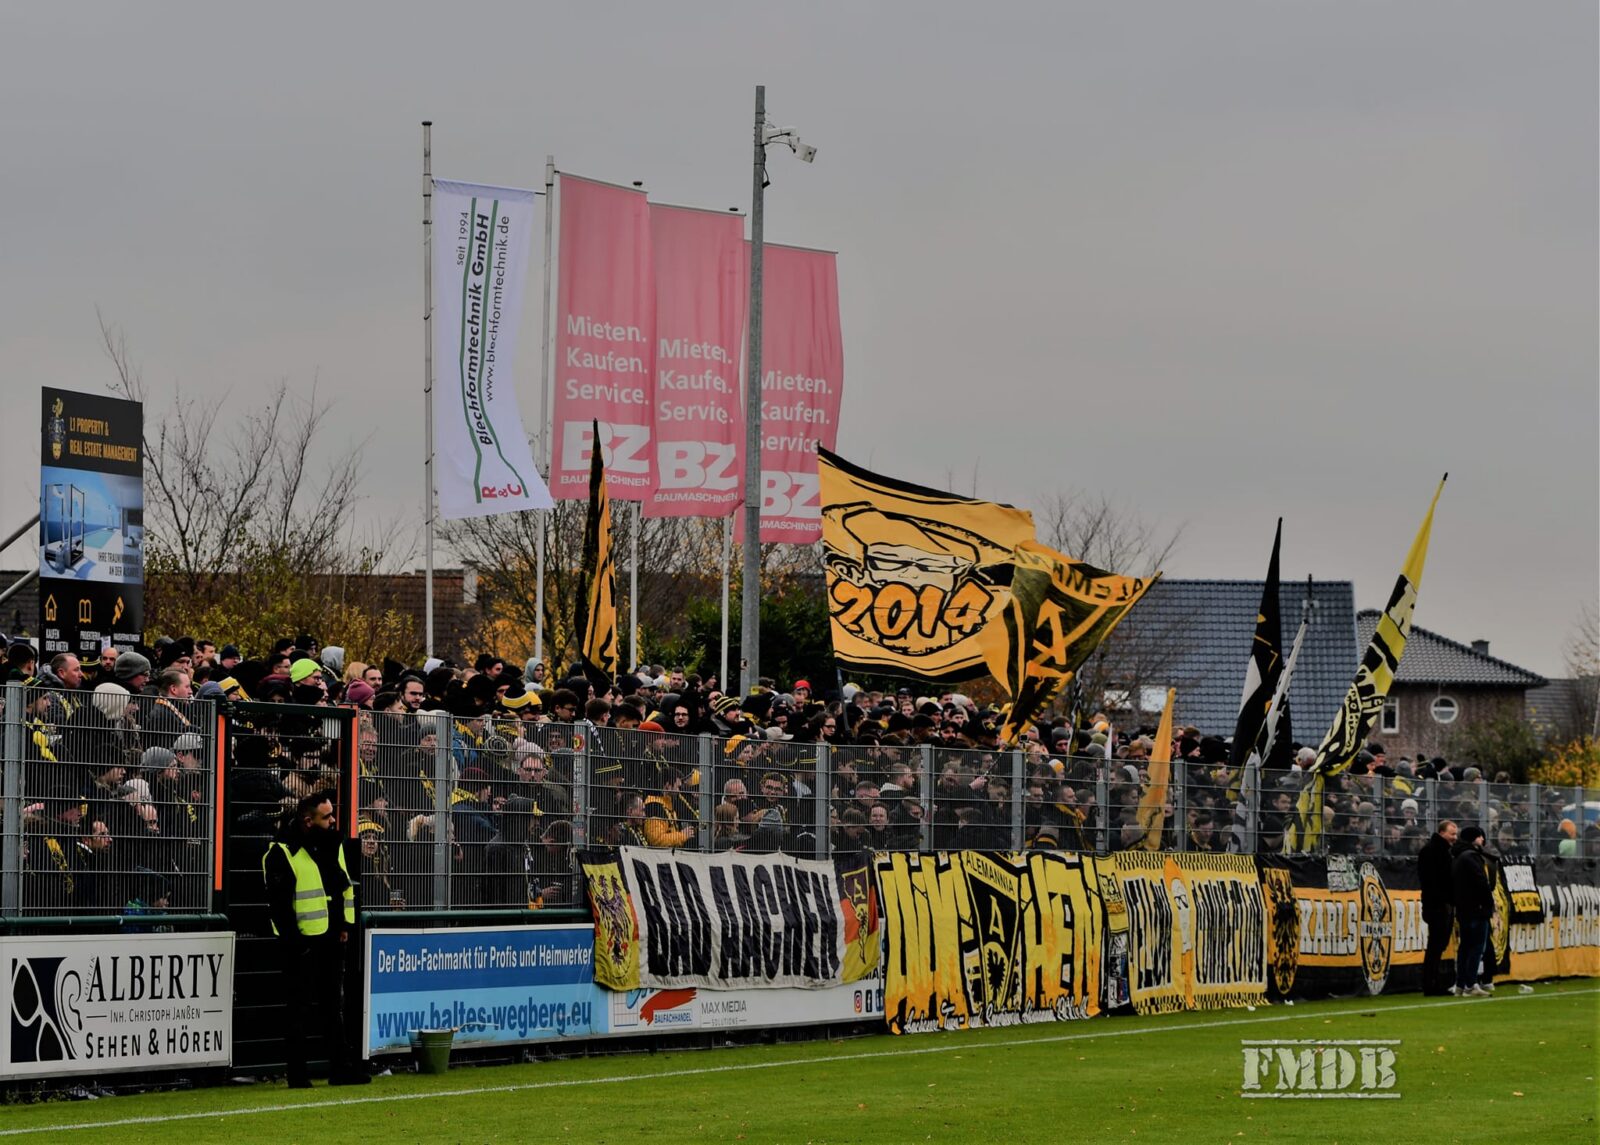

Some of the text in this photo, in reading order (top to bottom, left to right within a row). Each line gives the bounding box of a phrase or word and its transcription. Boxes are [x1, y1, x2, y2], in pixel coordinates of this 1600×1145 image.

[459, 212, 469, 241] 1994
[472, 214, 489, 276] GmbH
[487, 215, 510, 402] www.blechformtechnik.de
[567, 314, 647, 342] Mieten.
[466, 284, 492, 445] Blechformtechnik
[566, 346, 648, 374] Kaufen.
[566, 379, 649, 405] Service.
[76, 417, 104, 436] PROPERTY
[561, 421, 650, 474] BZ
[69, 439, 138, 462] REAL ESTATE MANAGEMENT
[657, 440, 738, 491] BZ
[560, 474, 650, 487] BAUSCHINEN
[760, 471, 822, 519] BZ
[829, 576, 995, 640] 2014
[966, 851, 1015, 894] ALEMANNIA
[632, 858, 841, 980] BAD AACHEN
[1298, 899, 1358, 956] KARLS
[86, 953, 225, 1003] ALBERTY
[378, 943, 592, 974] Der Bau-Fachmarkt für Profis und Heimwerker
[377, 996, 592, 1039] www.baltes-wegberg.eu
[654, 1011, 692, 1025] BAUFACHHANDEL
[701, 1000, 747, 1015] MAX MEDIA
[148, 1027, 159, 1056] &
